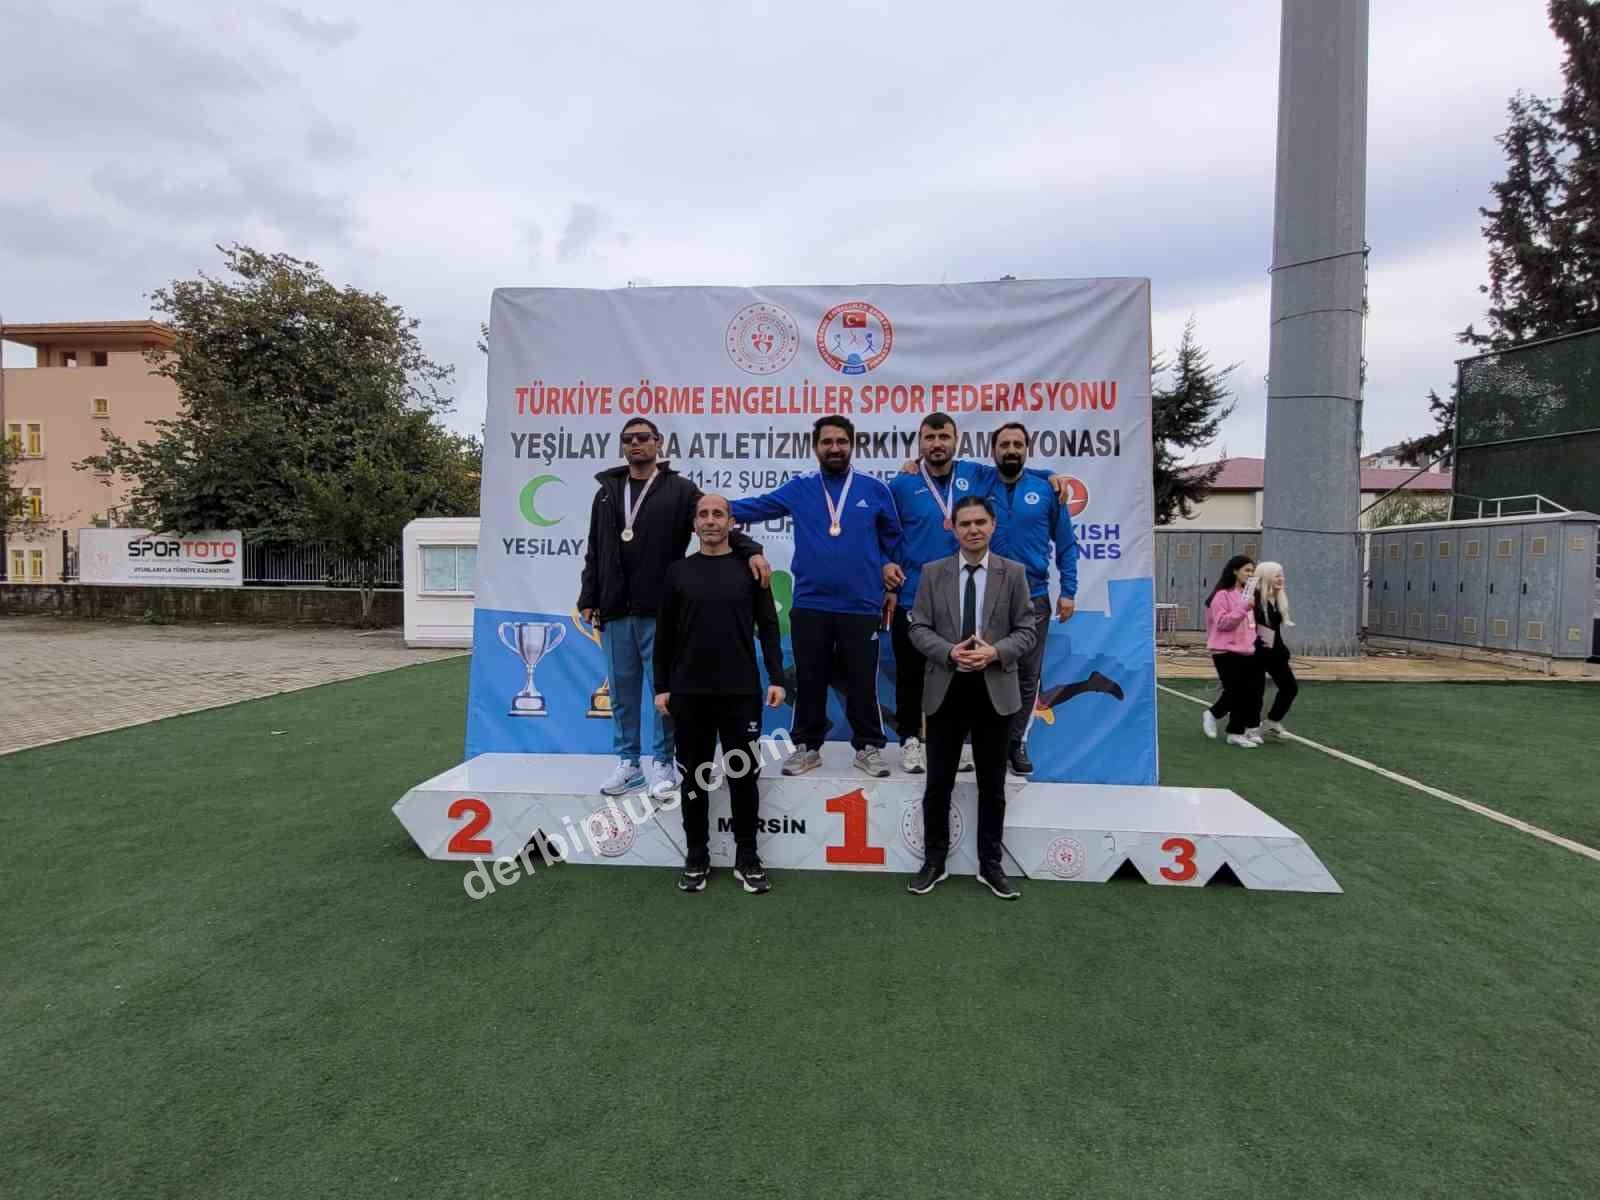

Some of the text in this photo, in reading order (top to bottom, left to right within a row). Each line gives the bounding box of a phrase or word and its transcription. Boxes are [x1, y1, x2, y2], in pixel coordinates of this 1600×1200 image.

[515, 379, 1117, 416] TÜRKİYE GÖRME ENGELLİLER SPOR FEDERASYONU
[510, 426, 611, 466] YEŞİLAY
[688, 426, 811, 459] ATLETİZM
[739, 470, 801, 494] ŞUBA
[447, 798, 492, 854] 2
[718, 815, 806, 834] MRSİN
[826, 788, 885, 864] 1
[1159, 837, 1197, 881] 3
